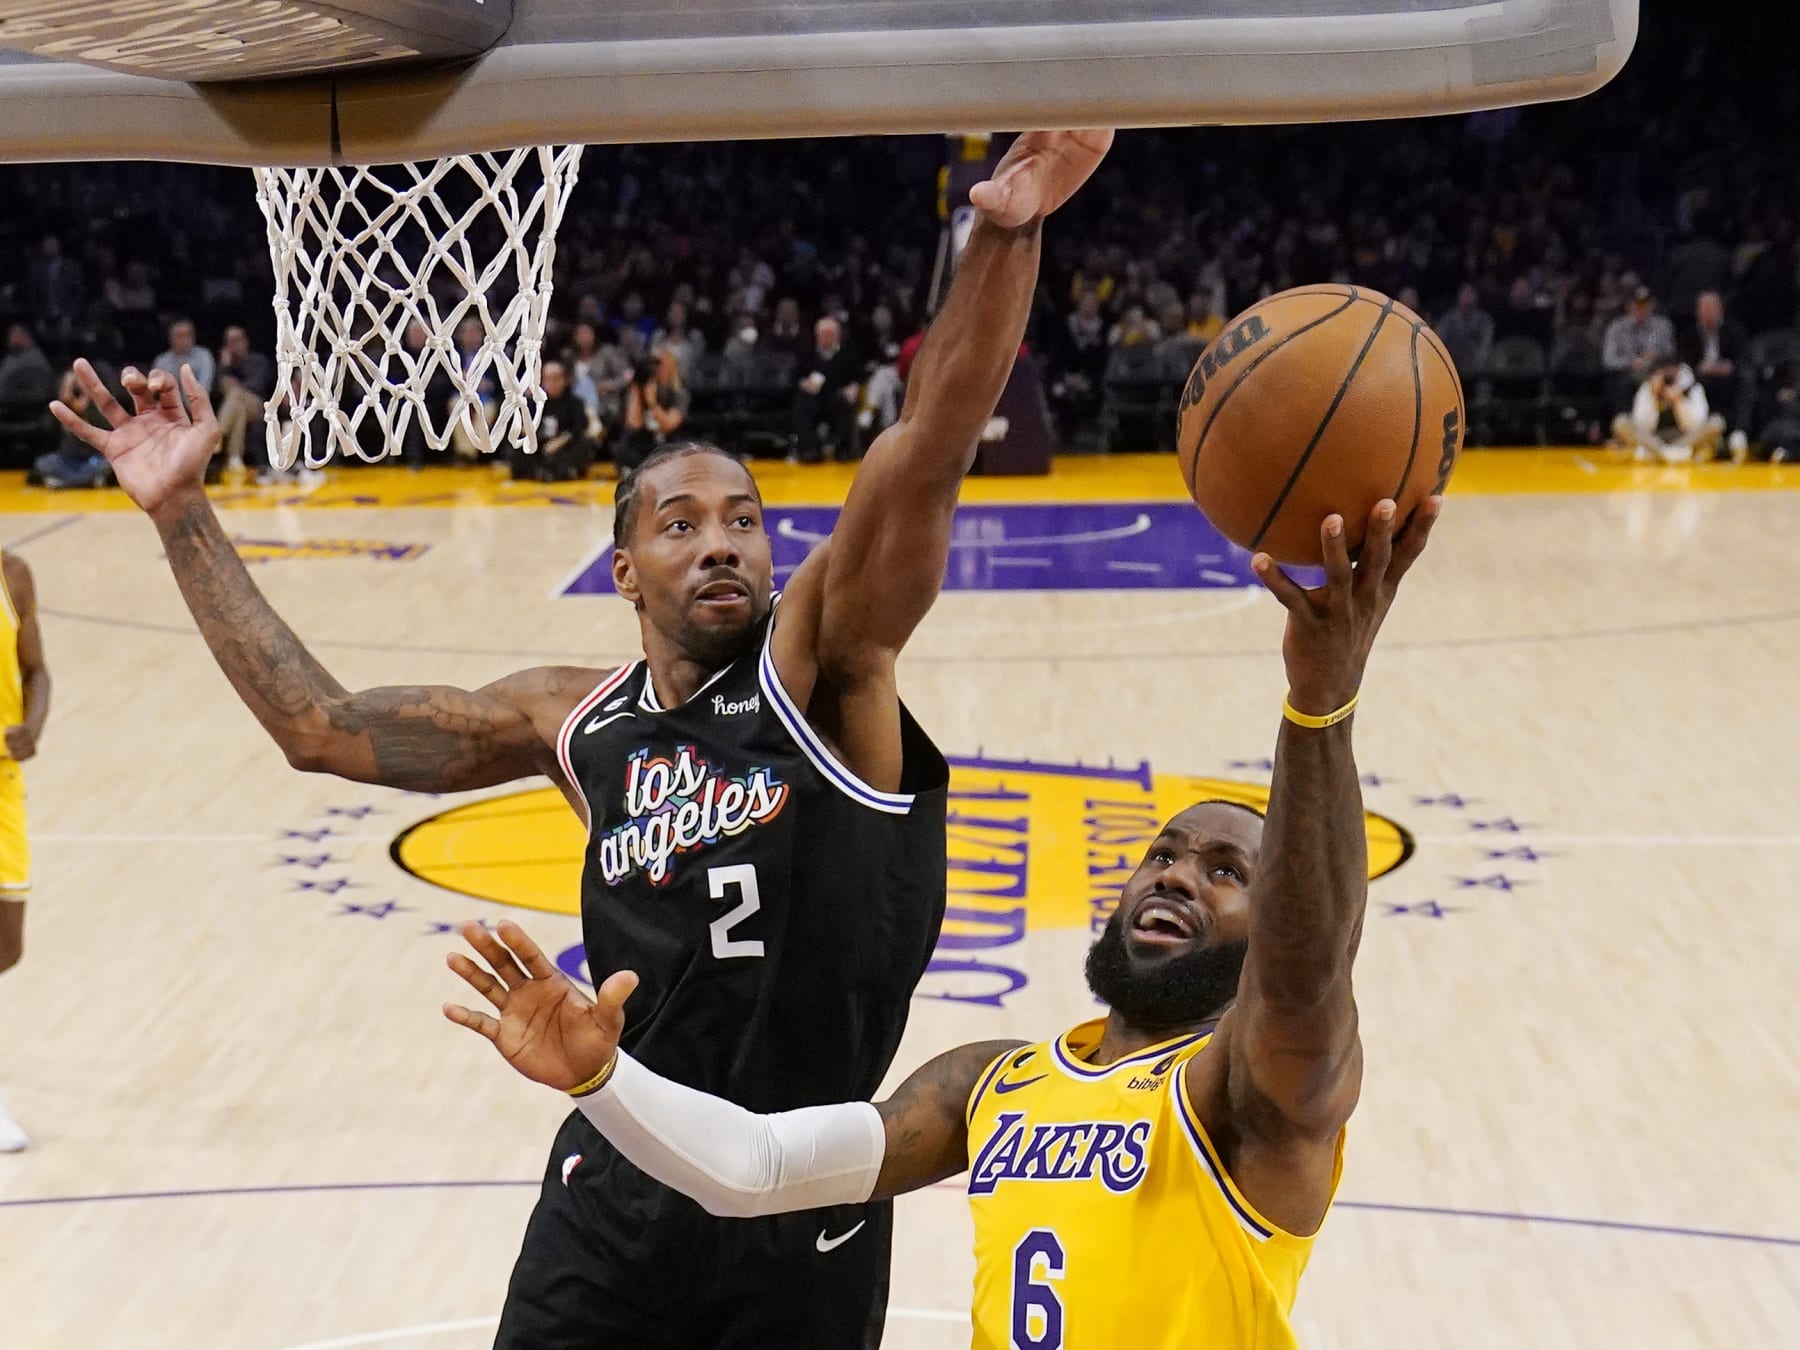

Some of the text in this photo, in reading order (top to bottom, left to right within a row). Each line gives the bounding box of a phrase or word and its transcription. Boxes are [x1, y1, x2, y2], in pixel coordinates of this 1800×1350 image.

[600, 771, 784, 882] angeles
[625, 750, 707, 818] los
[707, 863, 765, 959] 2
[967, 1110, 1153, 1198] LAKERS
